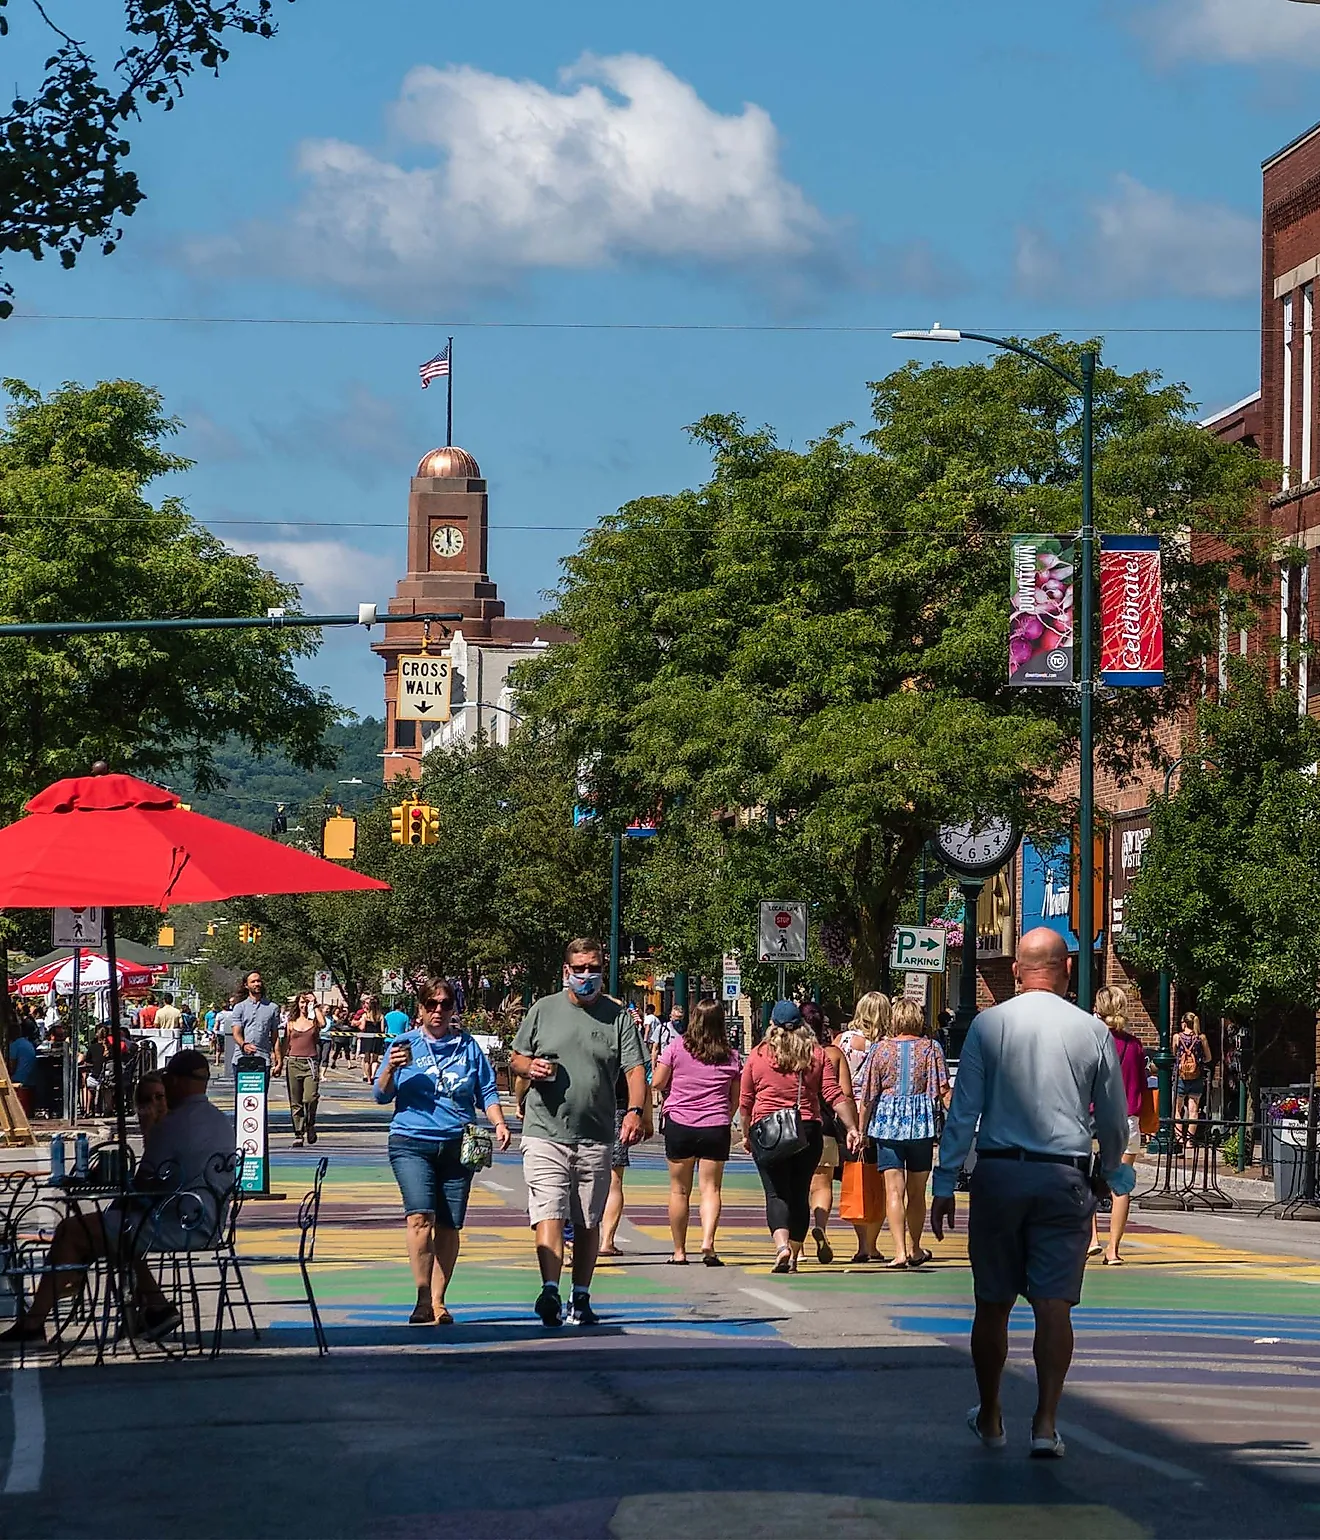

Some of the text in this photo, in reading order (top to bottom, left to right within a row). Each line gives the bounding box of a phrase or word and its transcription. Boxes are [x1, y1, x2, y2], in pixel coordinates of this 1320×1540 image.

[1019, 545, 1037, 612] DOWNTOWN
[1121, 554, 1141, 669] Celebrate!
[402, 662, 448, 677] CROSS
[406, 681, 442, 695] WALK
[993, 835, 1001, 846] 4
[968, 848, 976, 859] 6
[983, 845, 991, 856] 5
[897, 931, 940, 966] PARKING
[21, 983, 49, 994] KRONOS
